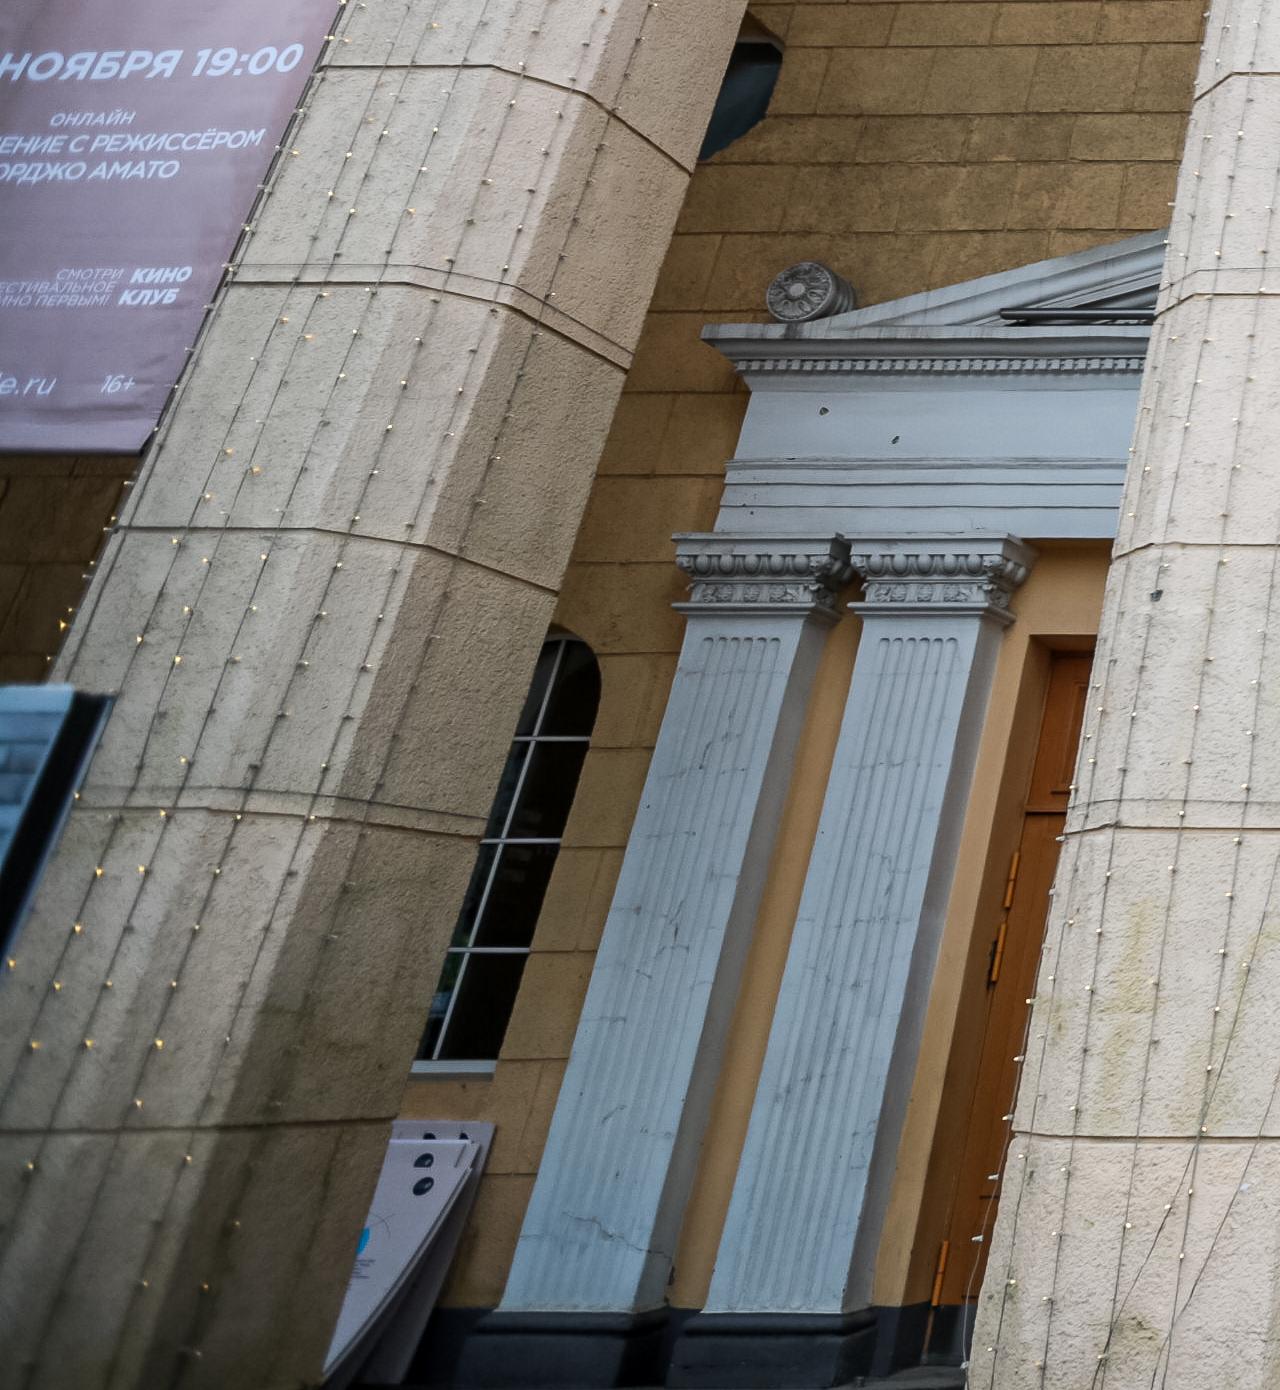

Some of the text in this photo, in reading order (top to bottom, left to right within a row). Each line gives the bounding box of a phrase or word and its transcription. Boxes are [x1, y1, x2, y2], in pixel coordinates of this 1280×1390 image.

[0, 43, 304, 81] НОЯБРЯ 19:00
[50, 109, 136, 127] ОНЛАЙН
[0, 128, 265, 155] ЕНИЕ С РЕЖИССЁРОМ
[89, 160, 180, 181] АМАТО
[56, 266, 193, 284] СМОТРИ КИНО
[118, 288, 180, 306] КЛУБ
[0, 372, 57, 397] e.ru
[100, 374, 136, 394] 16+
